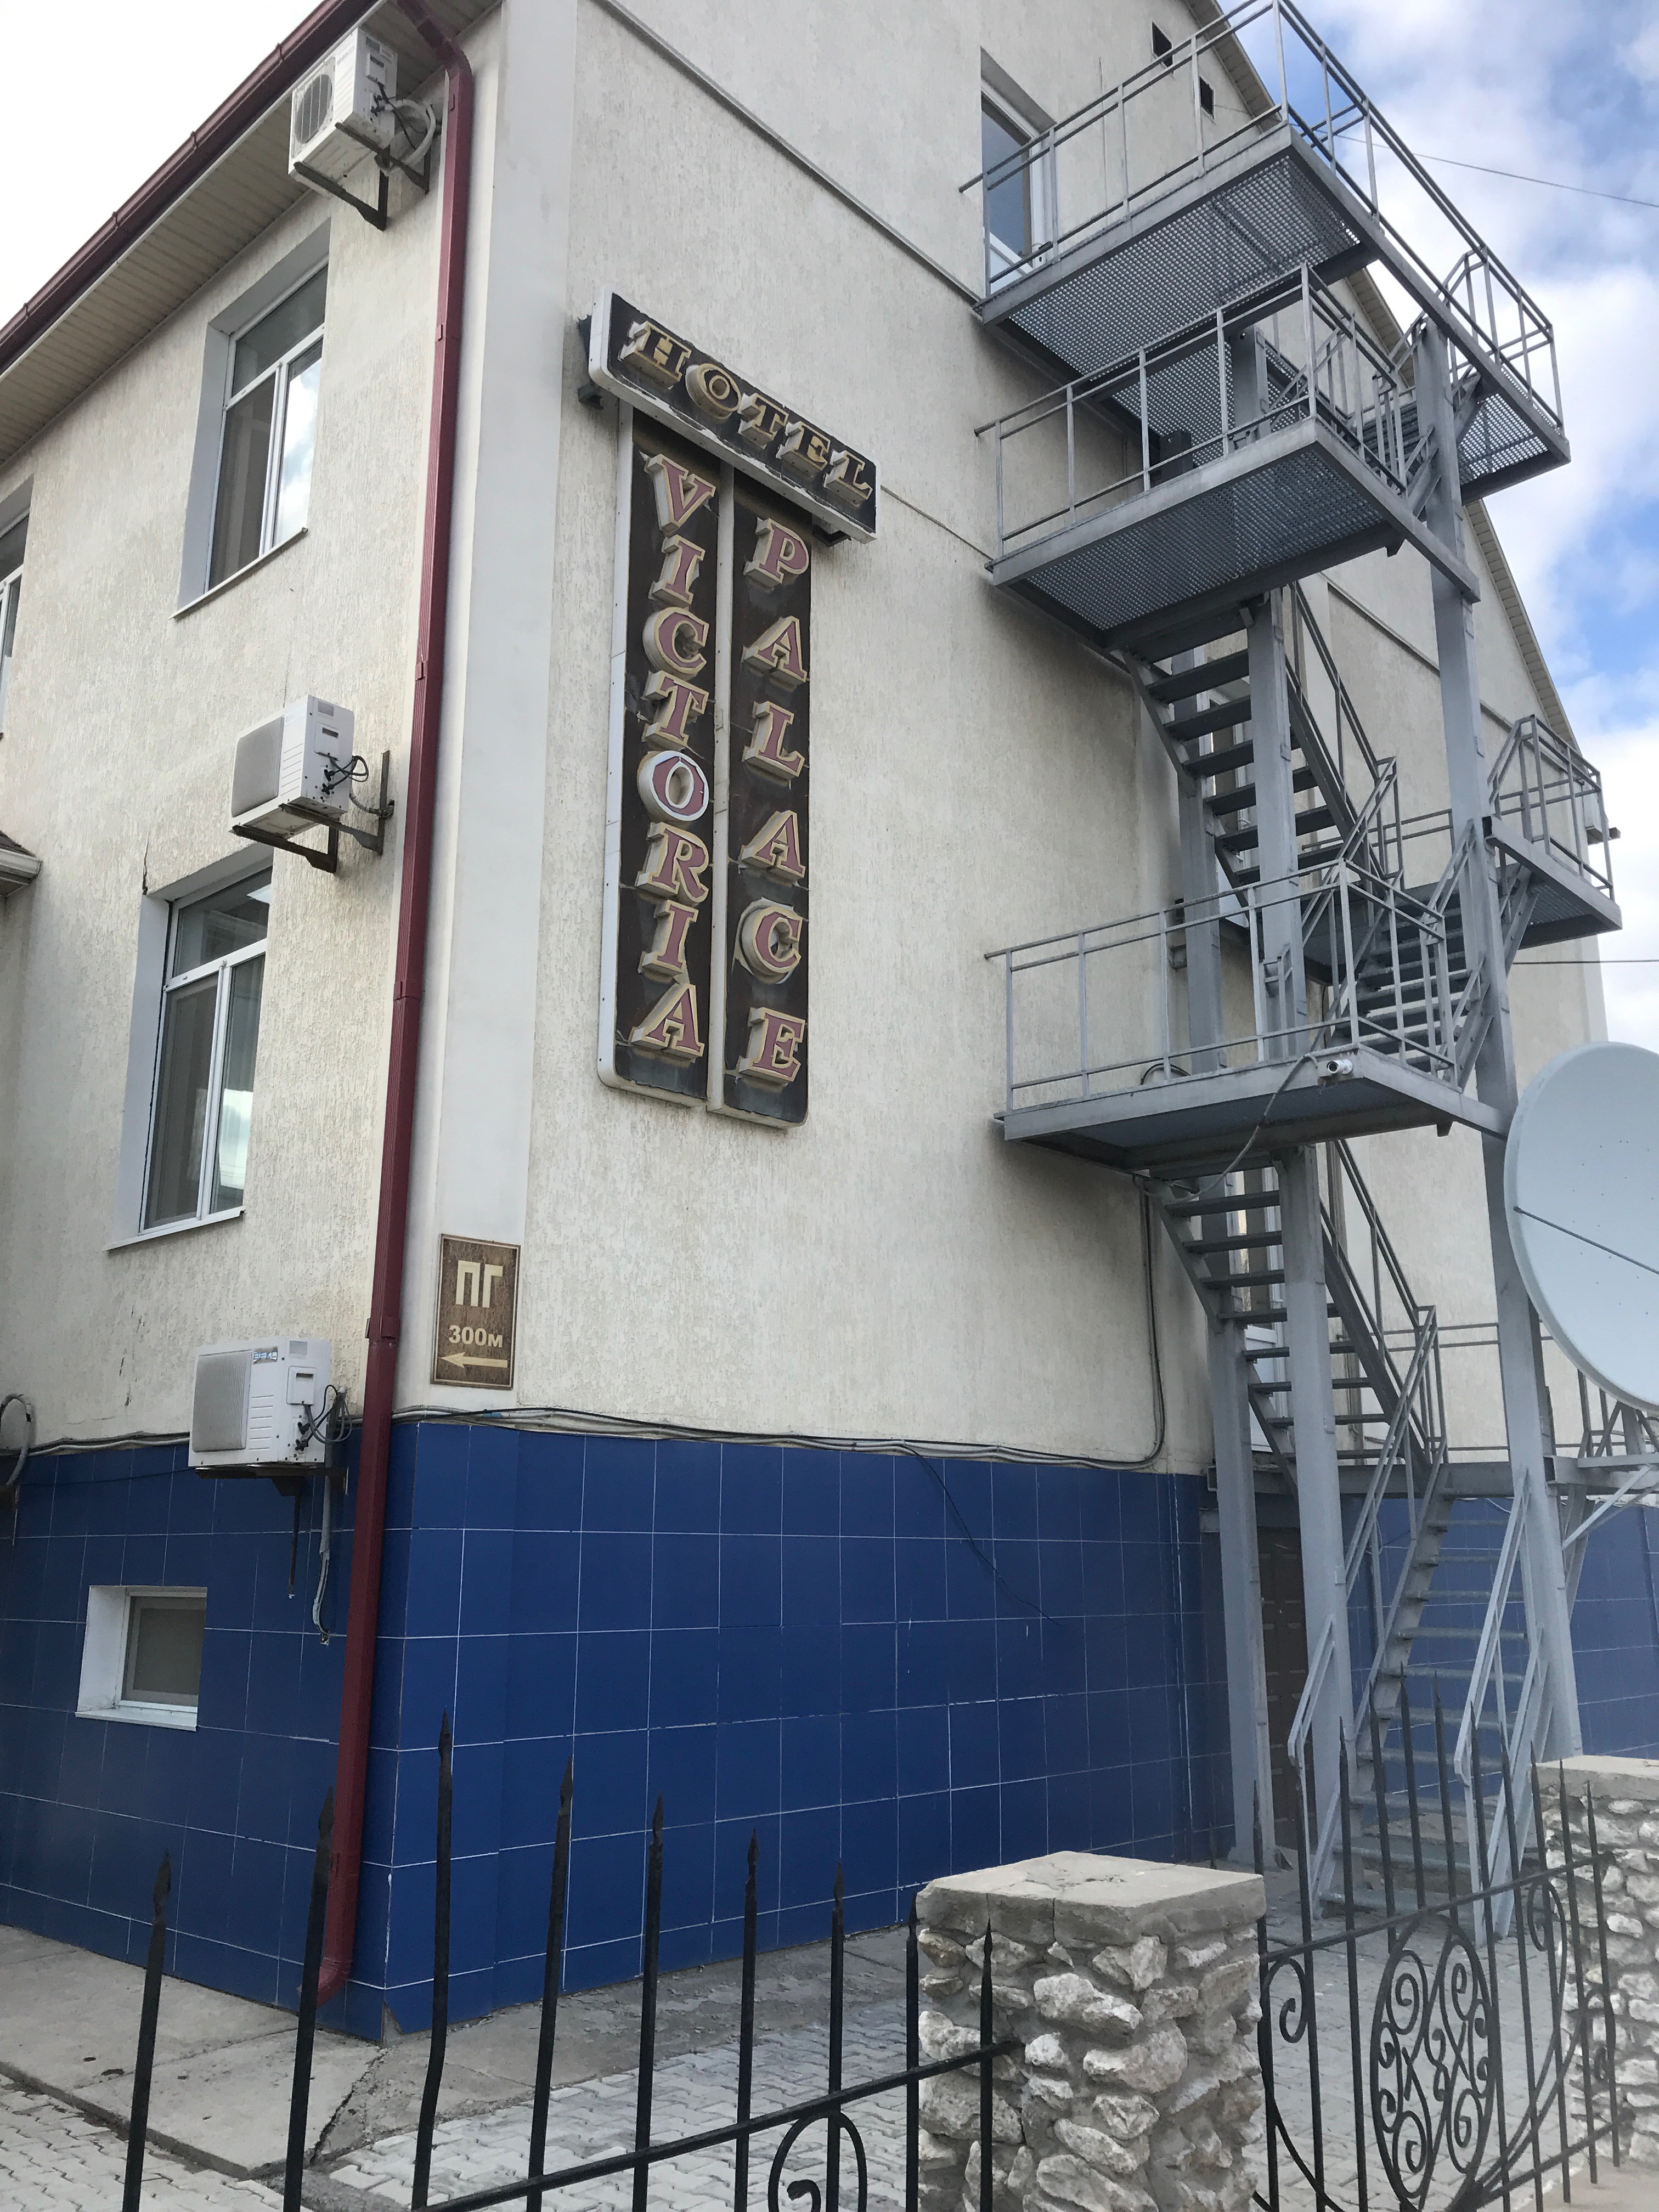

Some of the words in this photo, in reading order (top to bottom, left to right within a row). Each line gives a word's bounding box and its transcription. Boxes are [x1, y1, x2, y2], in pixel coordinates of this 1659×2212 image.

[619, 321, 873, 506] HOTEL
[631, 453, 715, 1063] VICTORIA
[737, 517, 810, 1084] PALACE
[455, 1260, 503, 1308] ПГ
